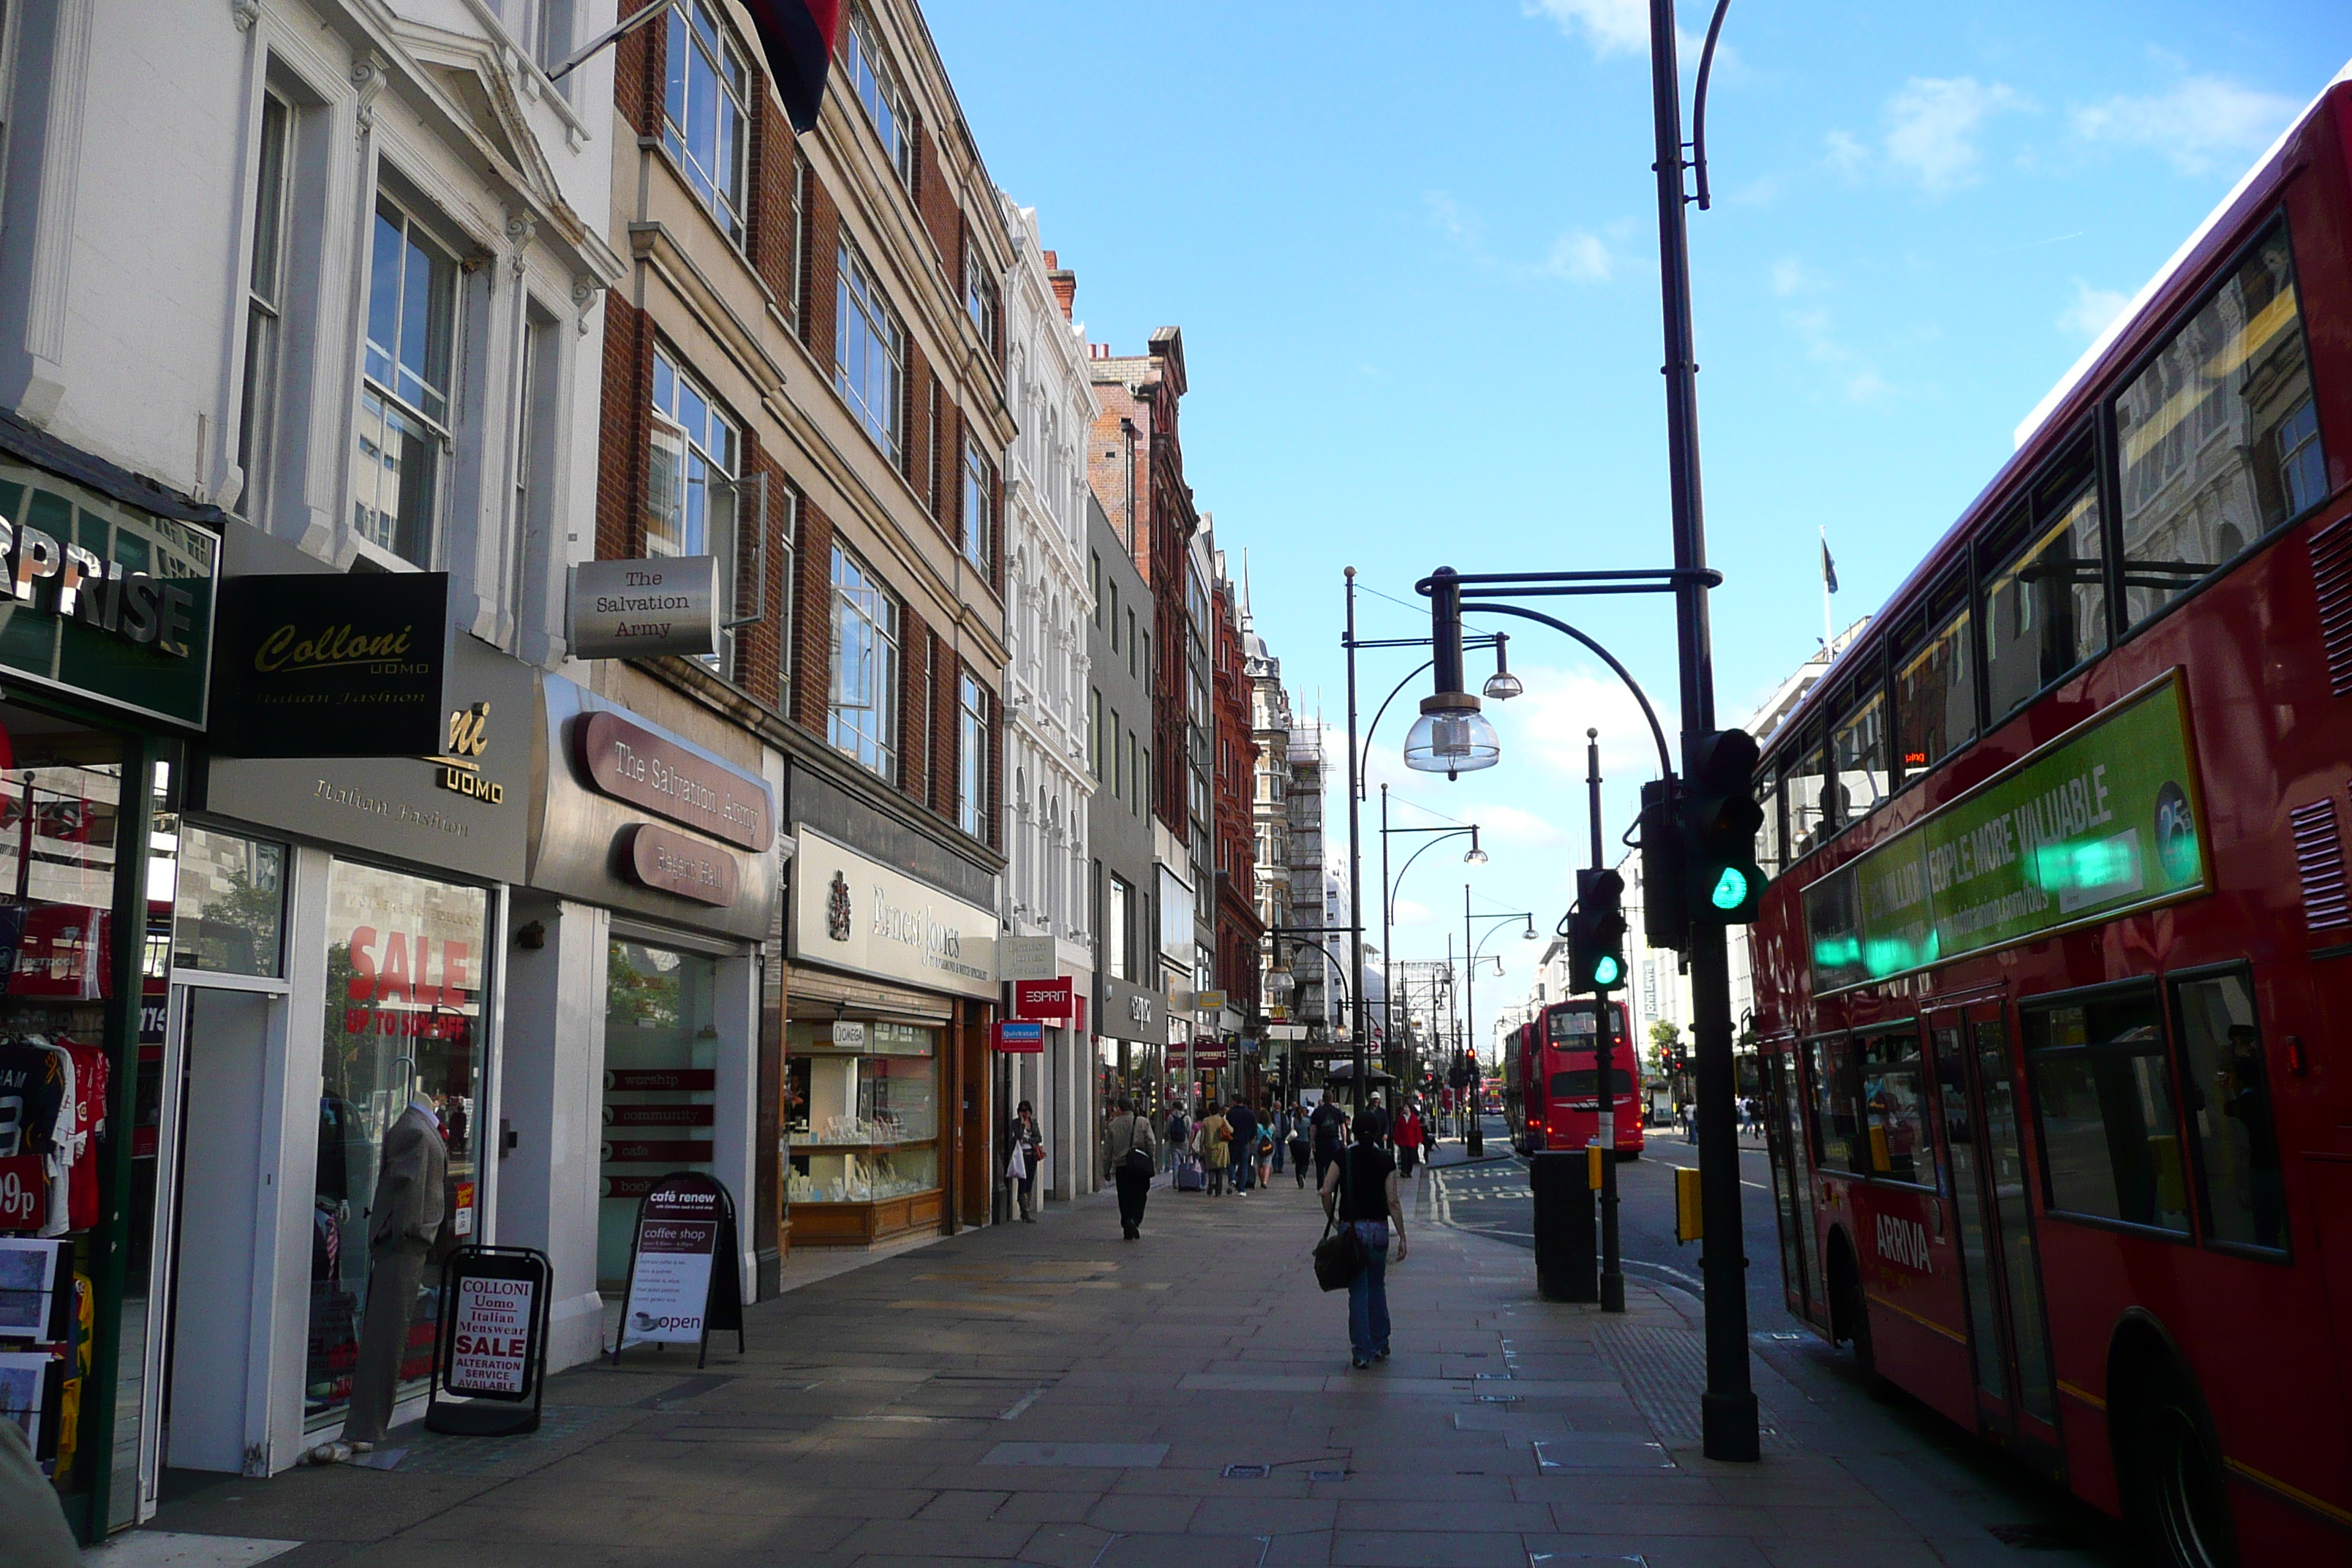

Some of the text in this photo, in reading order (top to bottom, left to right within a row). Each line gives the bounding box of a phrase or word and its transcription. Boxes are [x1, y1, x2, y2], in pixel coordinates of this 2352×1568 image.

[625, 571, 663, 587] The
[596, 594, 690, 613] Salvation
[614, 622, 672, 639] Army
[255, 624, 412, 671] Colloni
[370, 663, 429, 674] UOMO
[447, 767, 503, 804] UOMO
[615, 740, 760, 835] The Salvation Army
[314, 780, 469, 837] Italian Fashion
[1971, 813, 2016, 876] MORE
[2013, 764, 2114, 856] VALUABLE
[657, 845, 723, 889] Regent Hall
[872, 884, 960, 966] Ernest Jones
[348, 926, 467, 1008] SALE
[1025, 990, 1068, 1003] ESPRIT
[1643, 965, 1657, 1015] John Lewis
[346, 1008, 464, 1040] UP TO 50% OFF
[842, 1028, 864, 1041] OMEGA
[1003, 1030, 1039, 1039] Quickstart
[625, 1074, 679, 1087] worship
[623, 1109, 698, 1123] community
[622, 1145, 649, 1157] cafe
[0, 1171, 35, 1220] 9p
[650, 1190, 716, 1204] café renew
[644, 1227, 706, 1242] coffee shop
[1876, 1212, 1933, 1273] ARRIVA
[462, 1281, 529, 1296] COLLONI
[475, 1294, 514, 1308] Uomo
[471, 1311, 514, 1324] Italian
[657, 1315, 701, 1332] open
[459, 1322, 526, 1335] Menswear
[455, 1335, 525, 1359] SALE
[456, 1358, 521, 1371] ALTERATION
[465, 1369, 510, 1380] SERVICE
[458, 1379, 516, 1391] AVAILABLE
